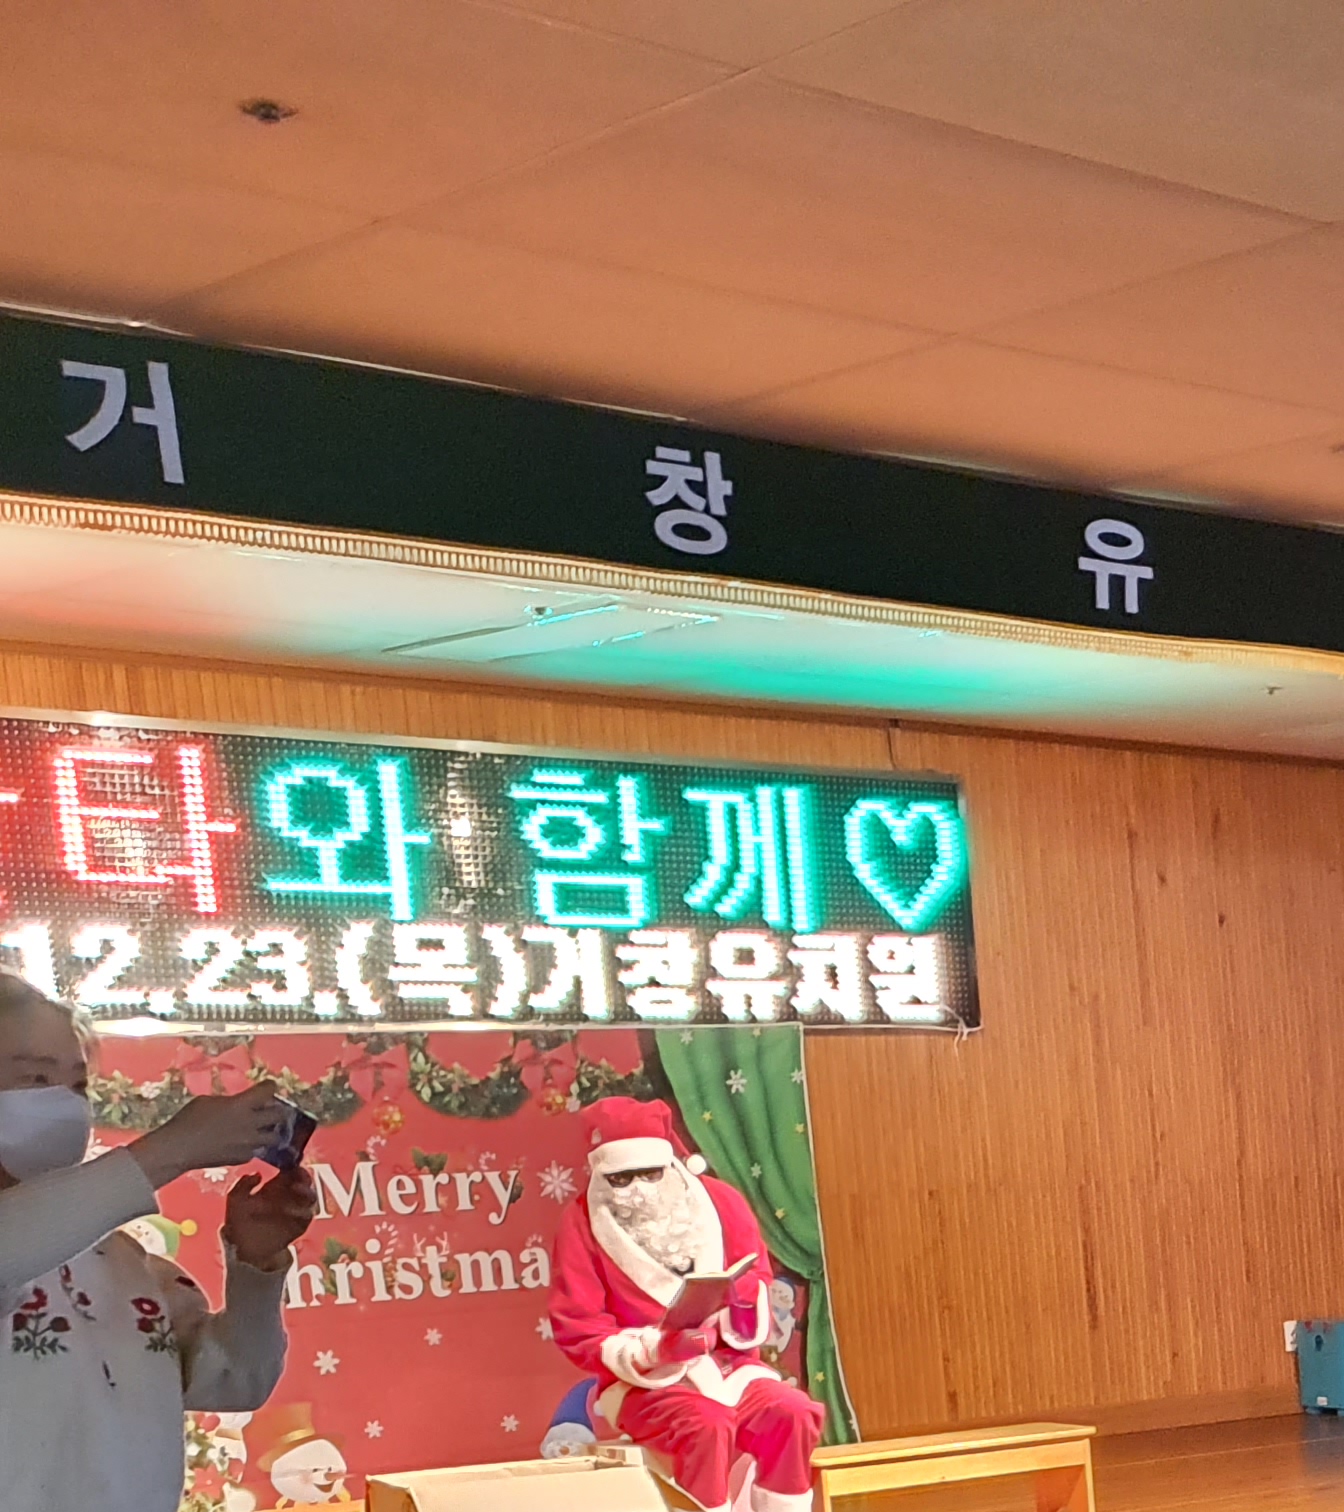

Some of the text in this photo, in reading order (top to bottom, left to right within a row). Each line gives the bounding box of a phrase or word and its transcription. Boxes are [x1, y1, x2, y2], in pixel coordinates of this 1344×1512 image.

[61, 360, 185, 486] 거
[645, 444, 734, 556] 창
[1077, 518, 1155, 616] 유
[0, 745, 816, 933] 타와 함께
[309, 1160, 519, 1225] Merry
[284, 1238, 550, 1309] hristma
